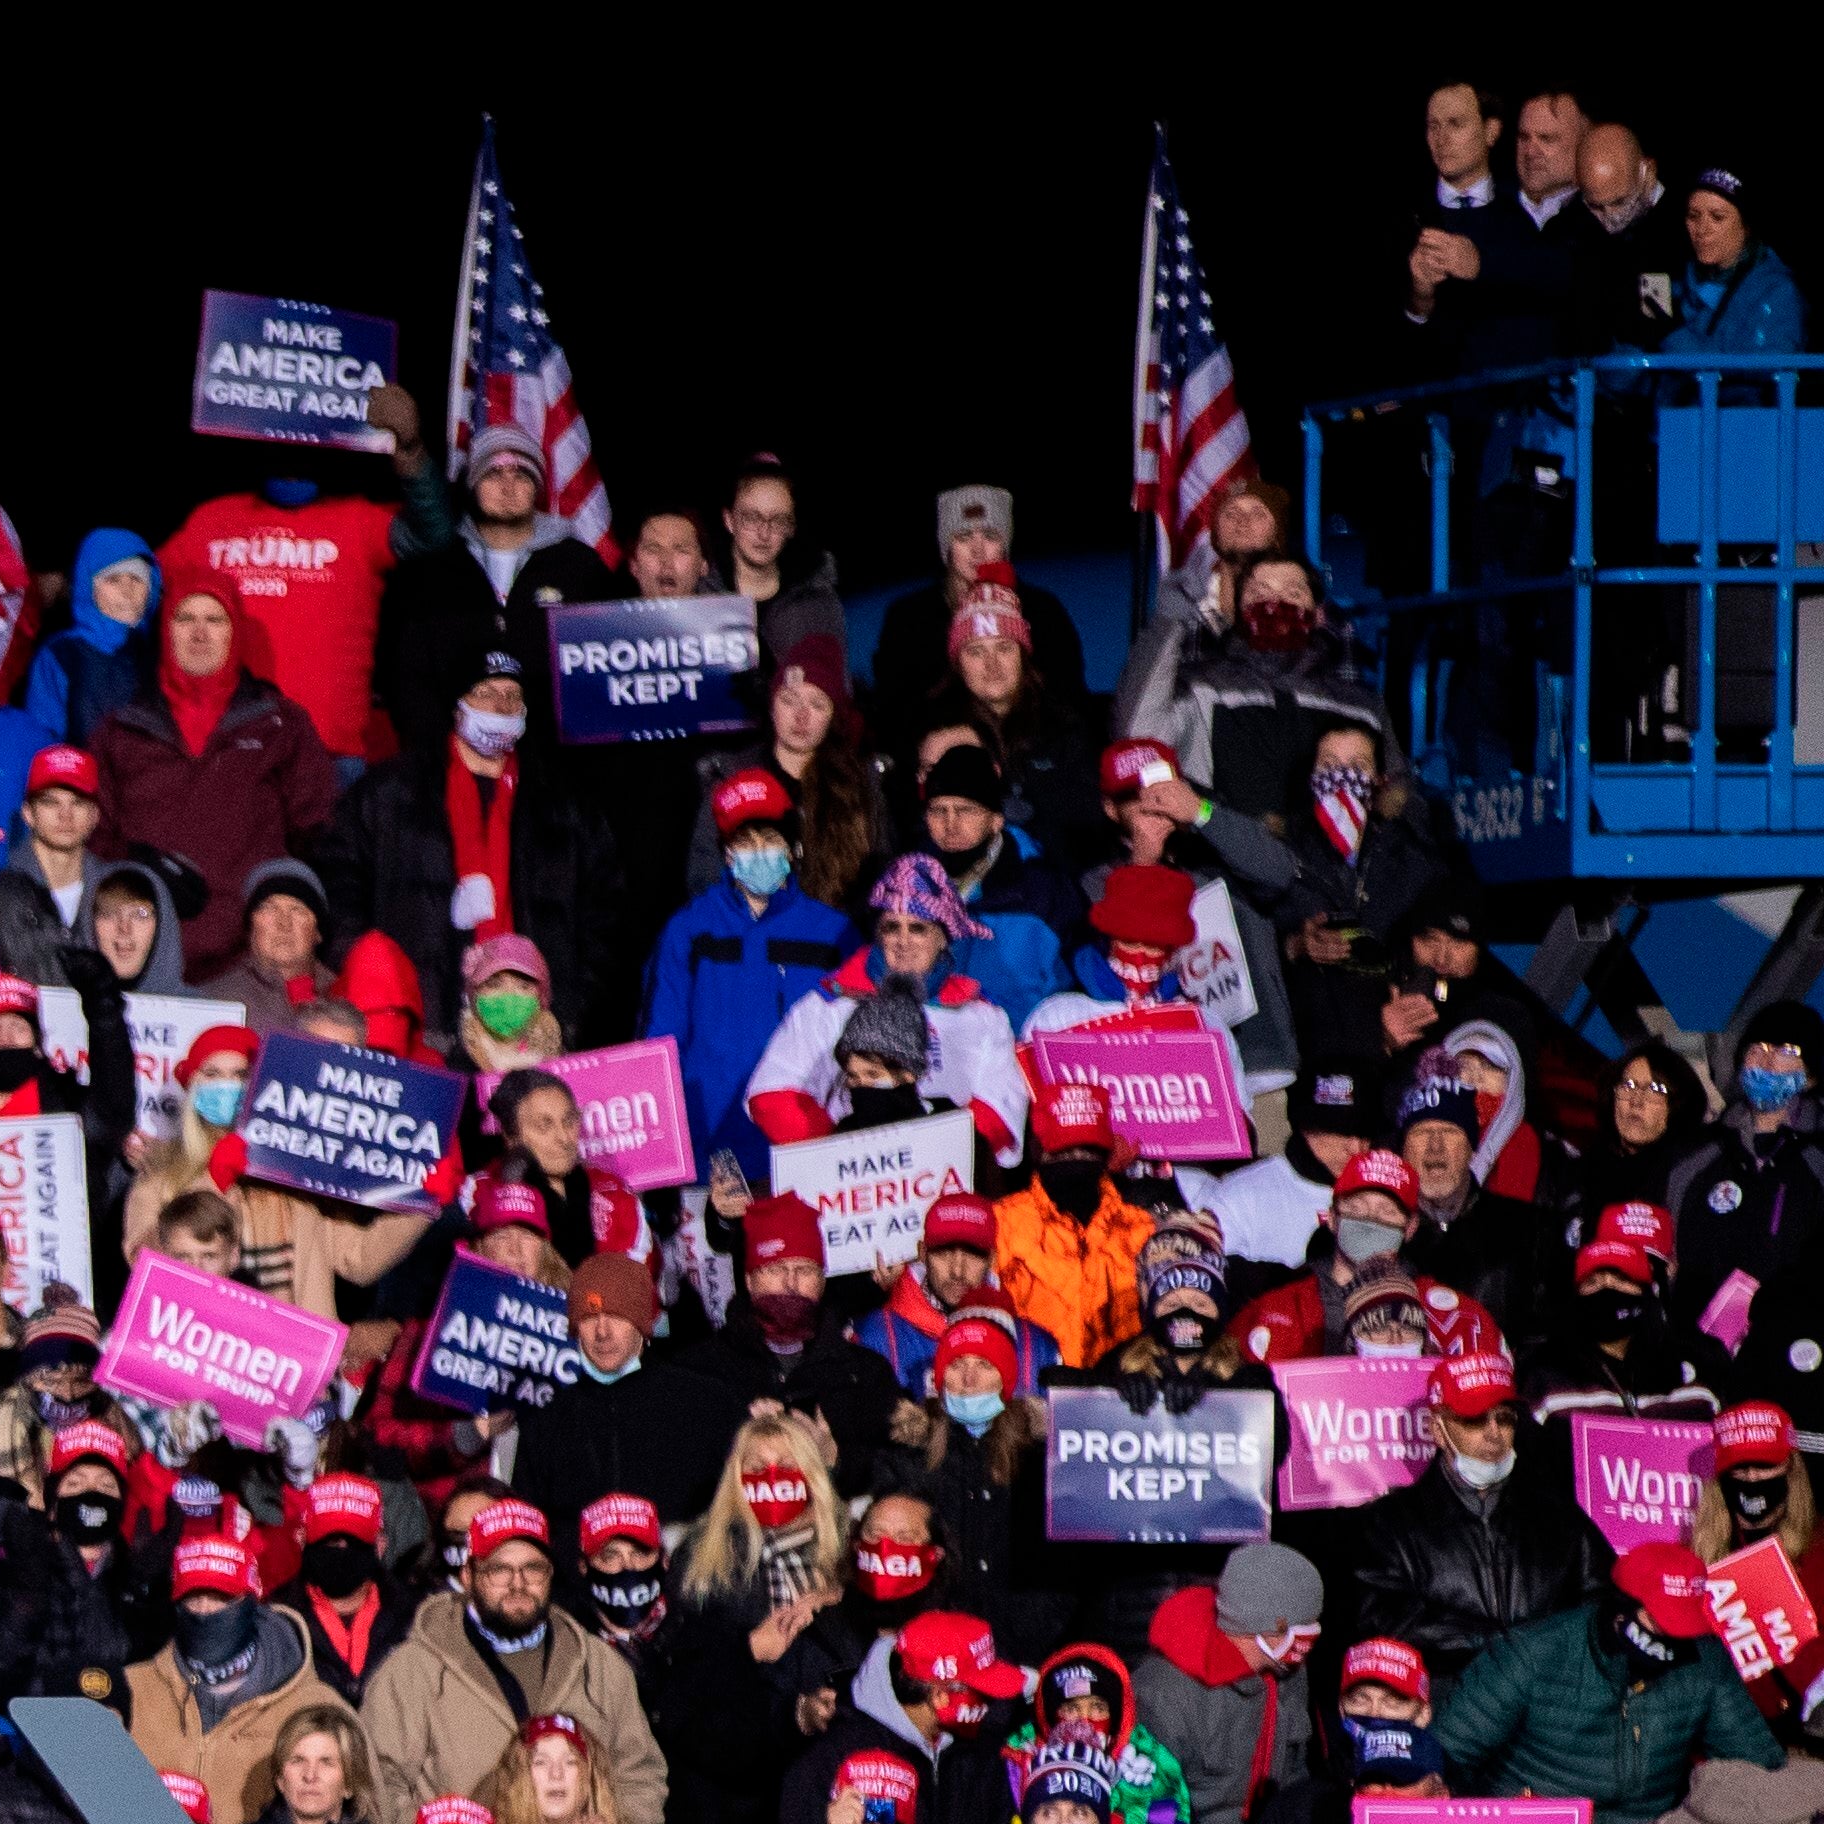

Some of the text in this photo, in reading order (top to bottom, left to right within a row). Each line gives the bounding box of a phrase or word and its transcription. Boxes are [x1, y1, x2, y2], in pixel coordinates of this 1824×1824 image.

[263, 319, 342, 352] MAKE
[211, 342, 385, 390] AMERICA
[210, 381, 368, 421] GREAT AGAI
[208, 538, 339, 570] TRUMP
[240, 581, 288, 597] 2020
[561, 630, 758, 675] PROMISES
[607, 671, 703, 706] KEPT
[316, 1061, 404, 1105] MAKE
[256, 1079, 442, 1158] AMERICA
[1129, 1104, 1202, 1123] TRUMP
[248, 1117, 433, 1191] GREAT AGAIN
[835, 1146, 914, 1177] MAKE
[818, 1167, 963, 1215] MERICA
[496, 1292, 569, 1337] MAKE
[150, 1294, 303, 1391] Women
[440, 1303, 592, 1381] AMERIC
[151, 1340, 275, 1408] FOR TRUMP
[434, 1350, 510, 1392] GREAT
[1303, 1400, 1435, 1446] Wome
[1057, 1427, 1267, 1464] PROMISES
[1323, 1442, 1435, 1463] FOR TRUM
[1106, 1469, 1210, 1503] KEPT
[1600, 1456, 1704, 1504] Wom
[1620, 1505, 1663, 1523] FOR
